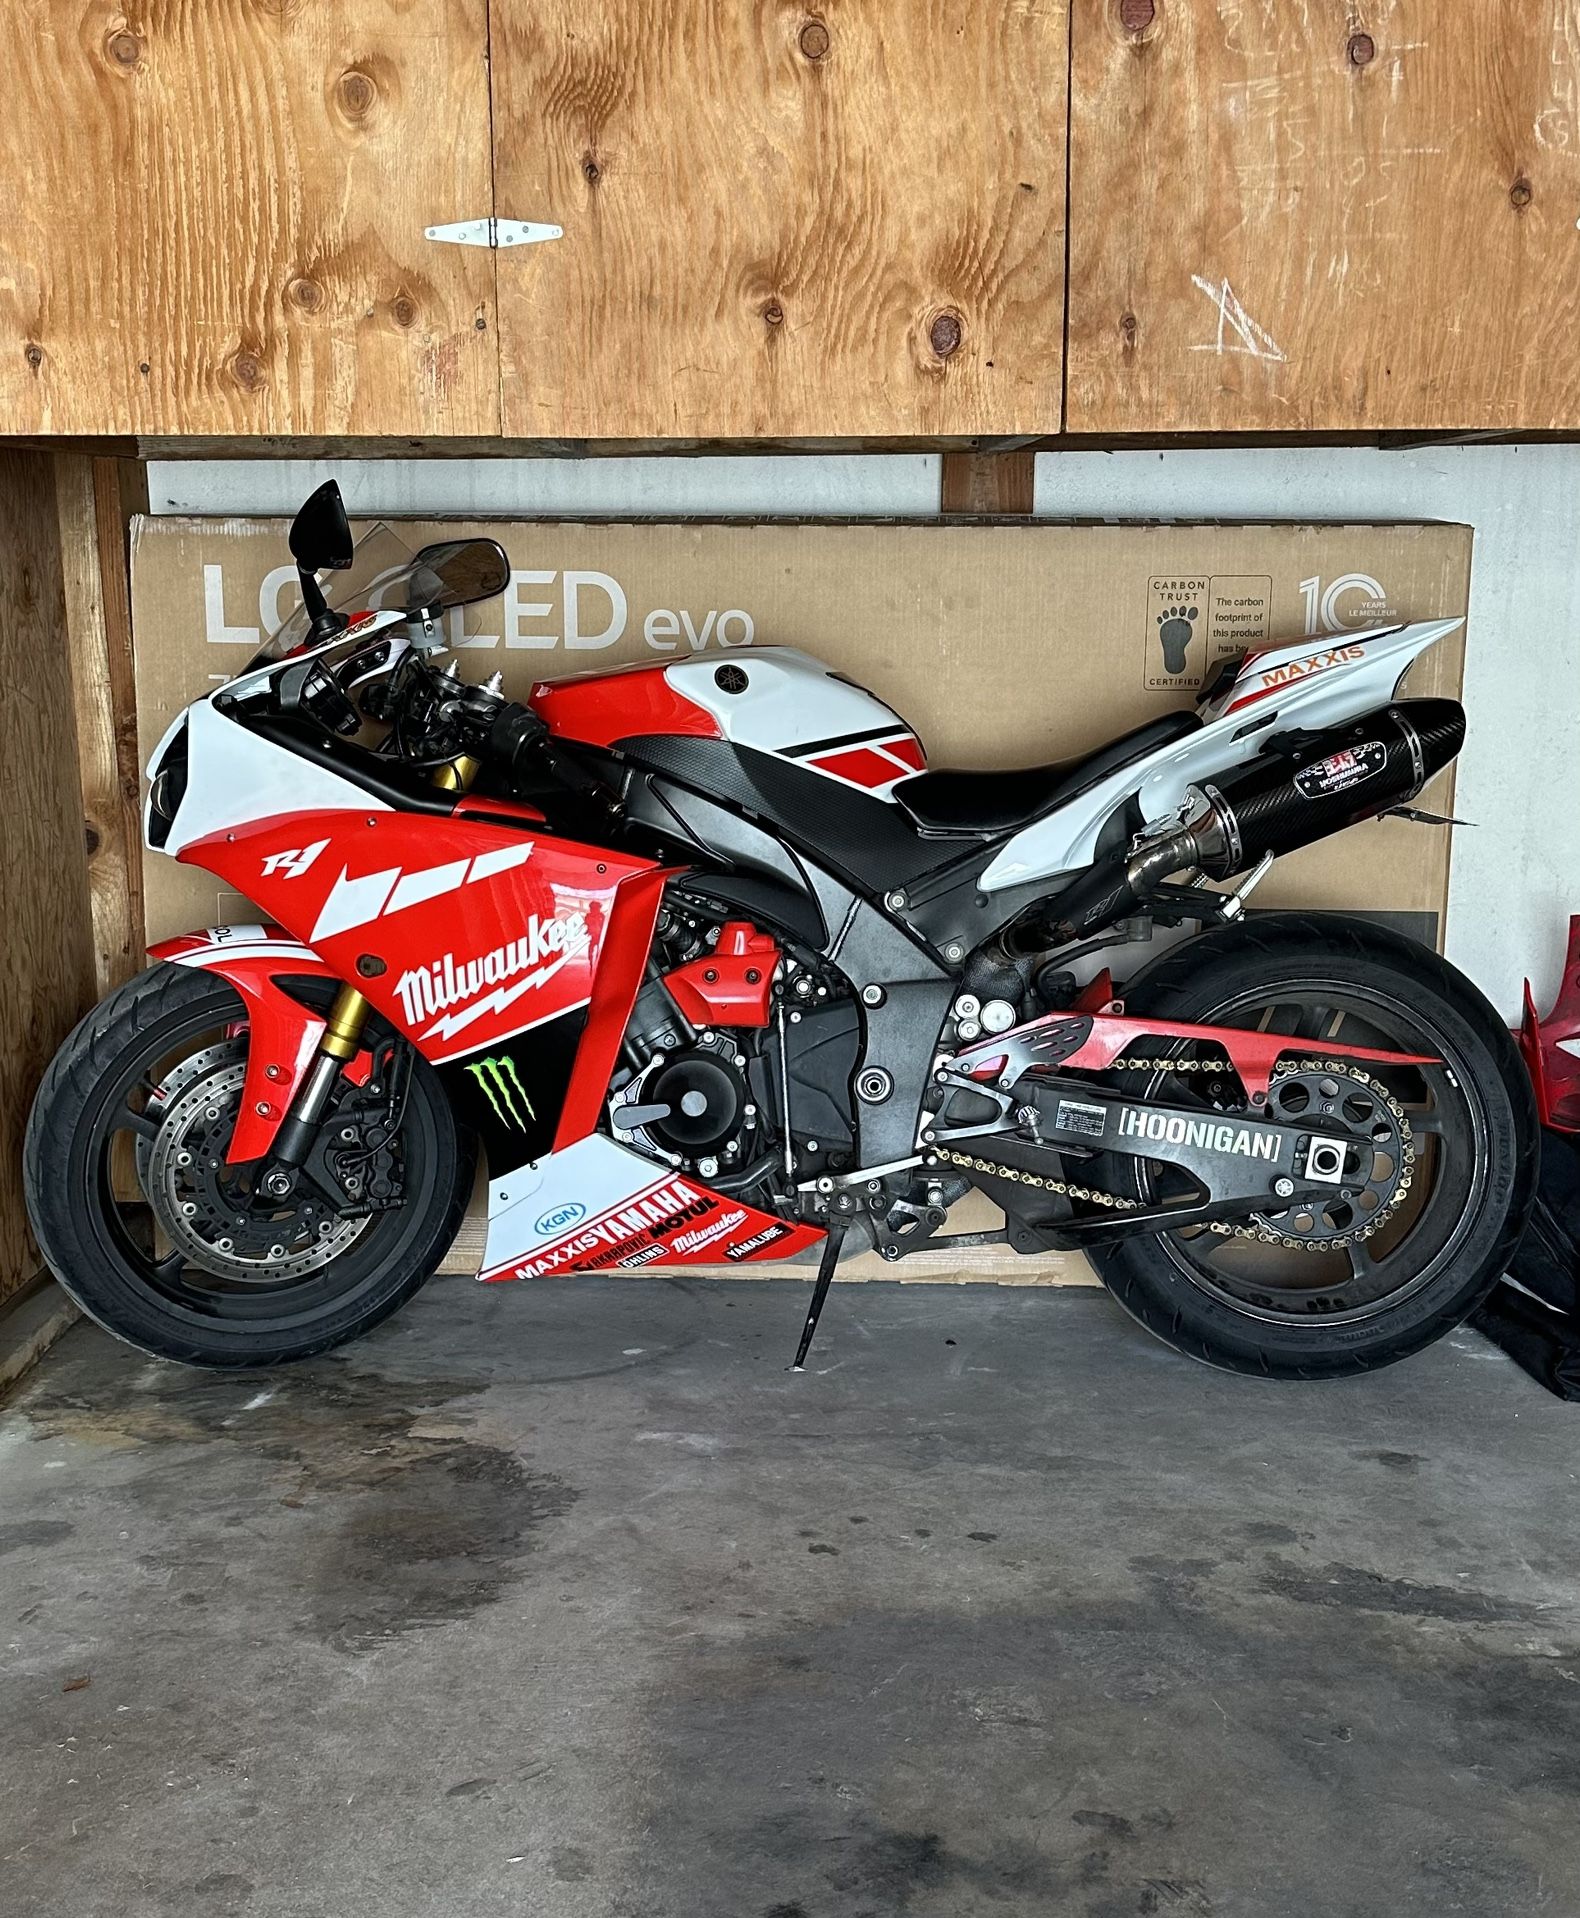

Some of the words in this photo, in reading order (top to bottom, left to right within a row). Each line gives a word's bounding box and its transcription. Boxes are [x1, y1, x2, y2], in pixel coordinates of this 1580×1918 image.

[1153, 581, 1205, 590] CARBON
[1159, 592, 1198, 601] TRUST
[1216, 597, 1232, 606] The
[1234, 597, 1264, 606] carbon
[1361, 601, 1386, 609] YEARS
[1215, 613, 1251, 622] footprint
[1253, 612, 1264, 621] of
[1359, 609, 1397, 617] MEILLEUR
[644, 609, 755, 650] evo
[1212, 628, 1229, 638] this
[1230, 628, 1264, 638] product
[1217, 643, 1234, 652] has
[1261, 645, 1365, 688] MAXXIS
[1149, 678, 1201, 686] CERTIFIED
[391, 911, 590, 1027] Milwaukee
[649, 1195, 721, 1240] MOTUL
[514, 1232, 600, 1280] MAXXIS
[588, 1180, 702, 1245] YAMAHA
[670, 1209, 747, 1253] Milwaukee
[726, 1226, 784, 1258] YAMALUBE
